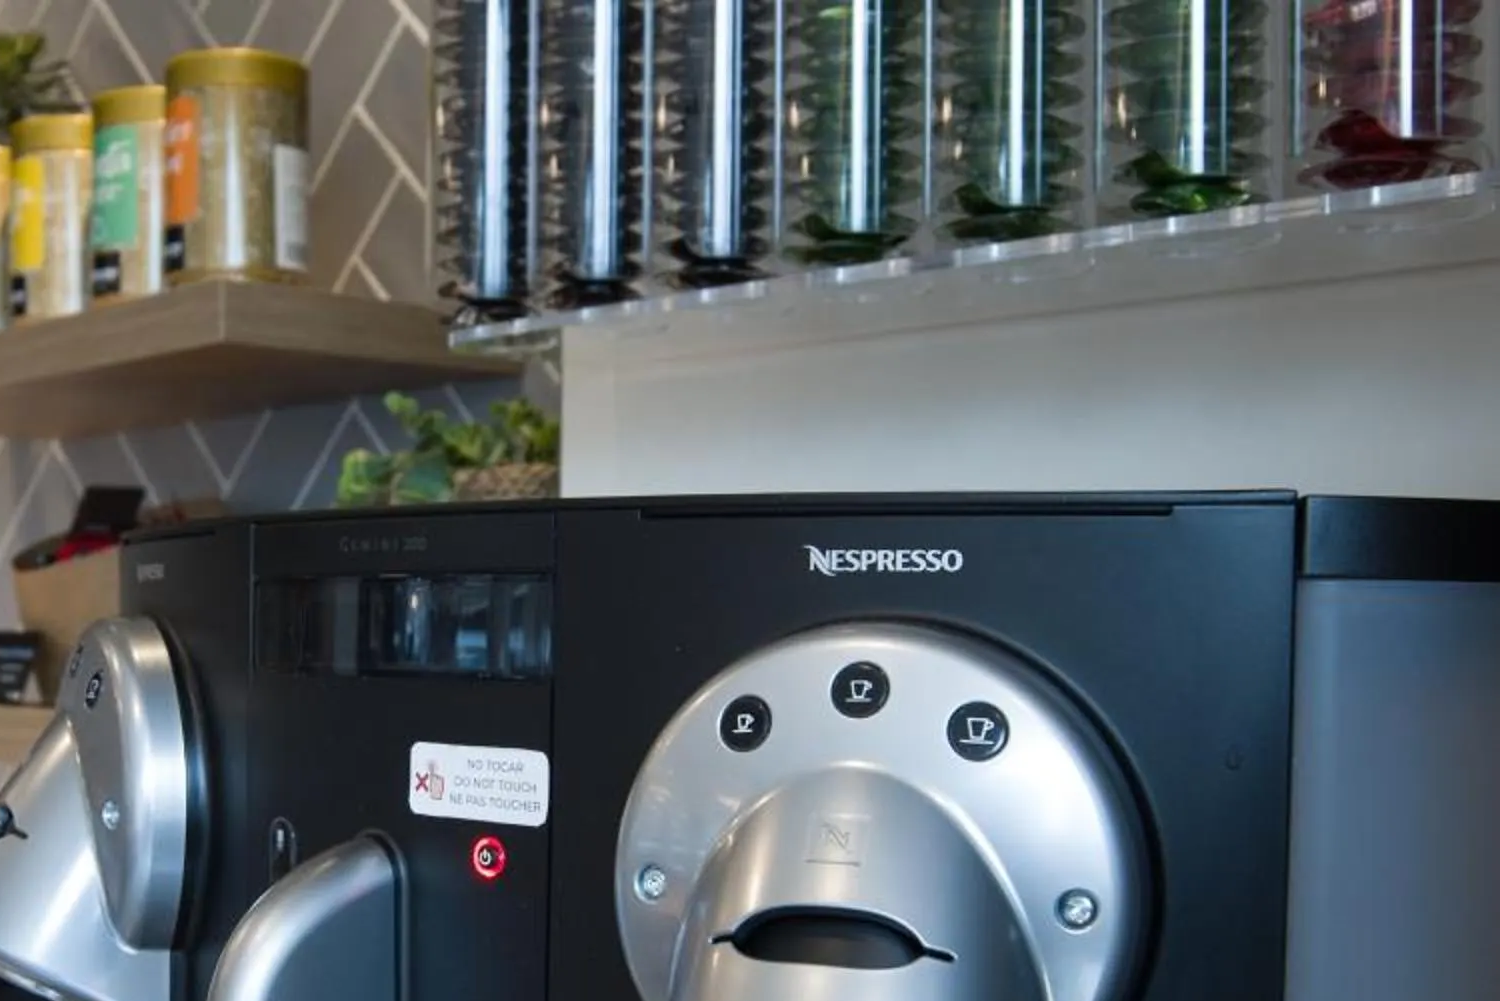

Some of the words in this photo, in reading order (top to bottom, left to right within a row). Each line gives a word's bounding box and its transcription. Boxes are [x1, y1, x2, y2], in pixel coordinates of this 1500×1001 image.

[804, 545, 963, 576] NESPRESSO
[467, 758, 484, 771] NO
[487, 759, 524, 774] TOCAR
[454, 775, 471, 787] DO
[473, 777, 495, 789] NOT
[499, 779, 537, 794] TOUCH
[449, 793, 463, 806] NE
[466, 794, 487, 808] PAS
[489, 796, 541, 813] TOUCHER
